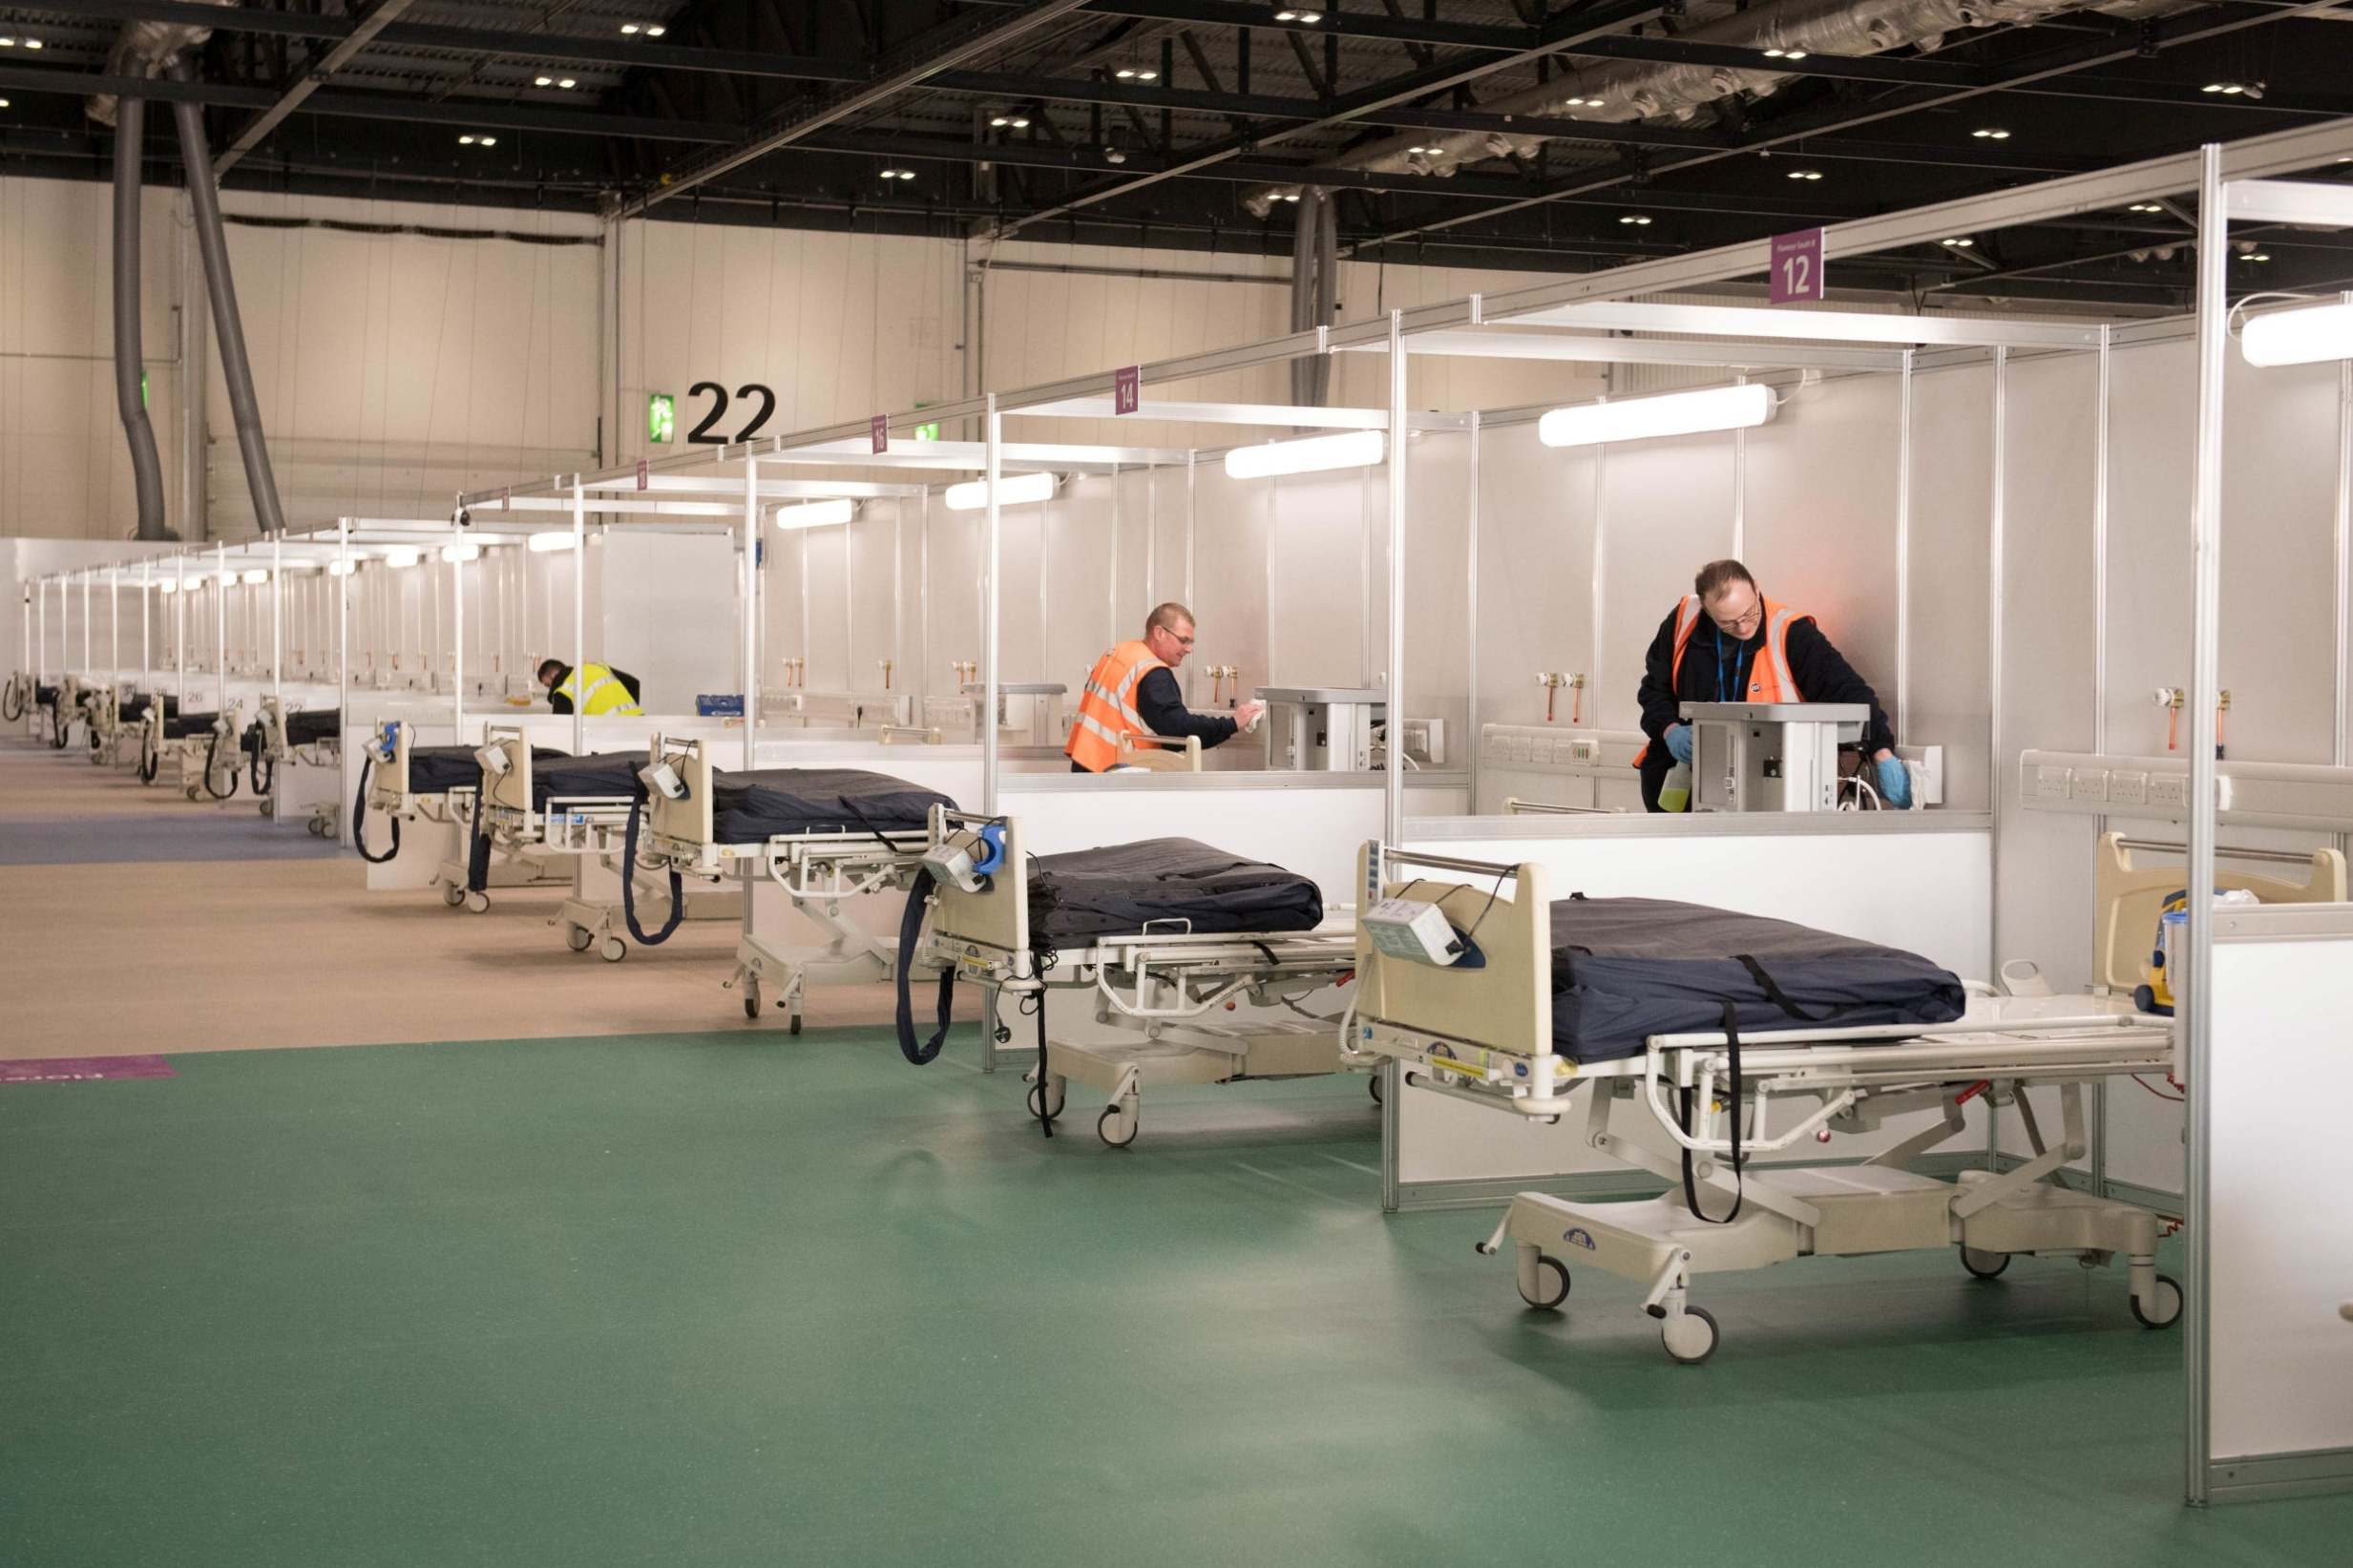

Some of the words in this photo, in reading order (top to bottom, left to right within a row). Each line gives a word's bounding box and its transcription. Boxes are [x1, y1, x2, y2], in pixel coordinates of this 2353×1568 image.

[1783, 255, 1810, 295] 12
[687, 381, 776, 445] 22
[1121, 382, 1133, 409] 14
